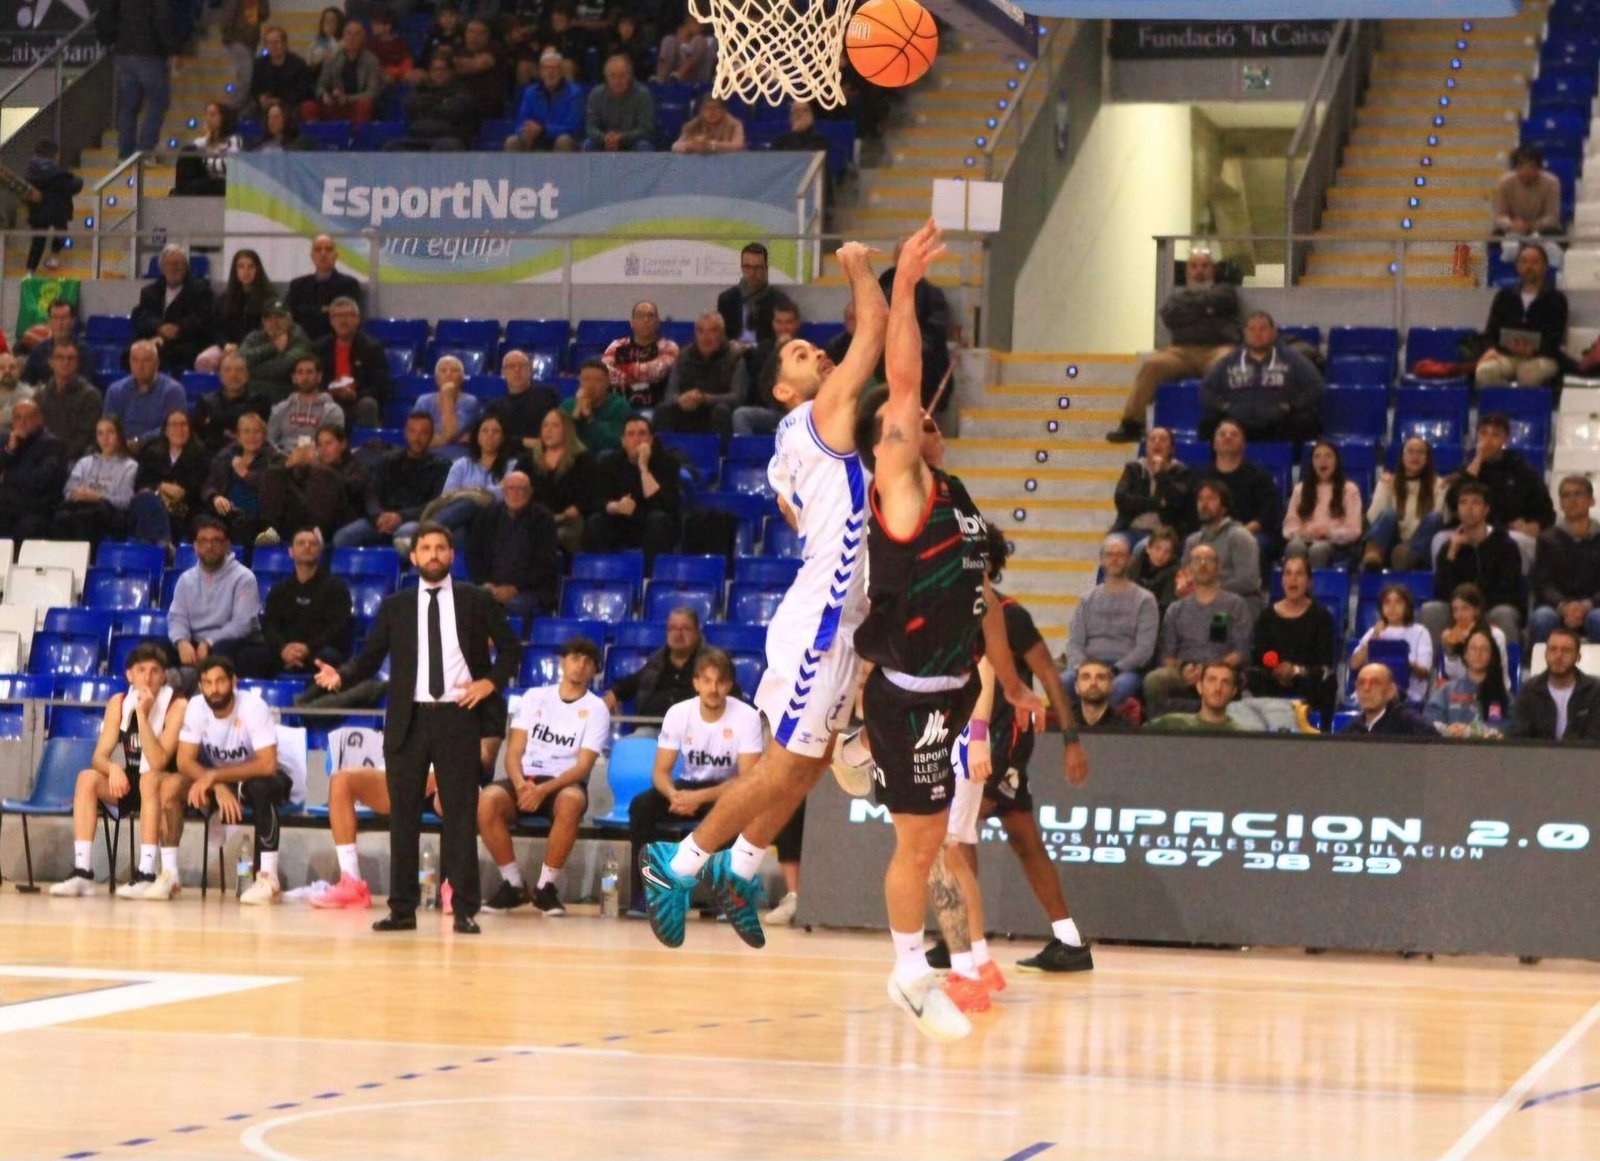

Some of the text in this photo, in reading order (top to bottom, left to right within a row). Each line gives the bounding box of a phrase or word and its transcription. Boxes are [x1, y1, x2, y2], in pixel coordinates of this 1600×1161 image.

[321, 177, 559, 226] EsportNet
[531, 723, 577, 747] fibwi
[207, 742, 248, 761] fibwi
[688, 750, 732, 767] fibwi
[1096, 833, 1256, 851] INTEGRALES
[1271, 839, 1300, 853] DE
[1467, 820, 1590, 849] 2.0
[1145, 848, 1223, 867] 07
[1243, 852, 1309, 871] 38
[1332, 855, 1402, 875] 39
